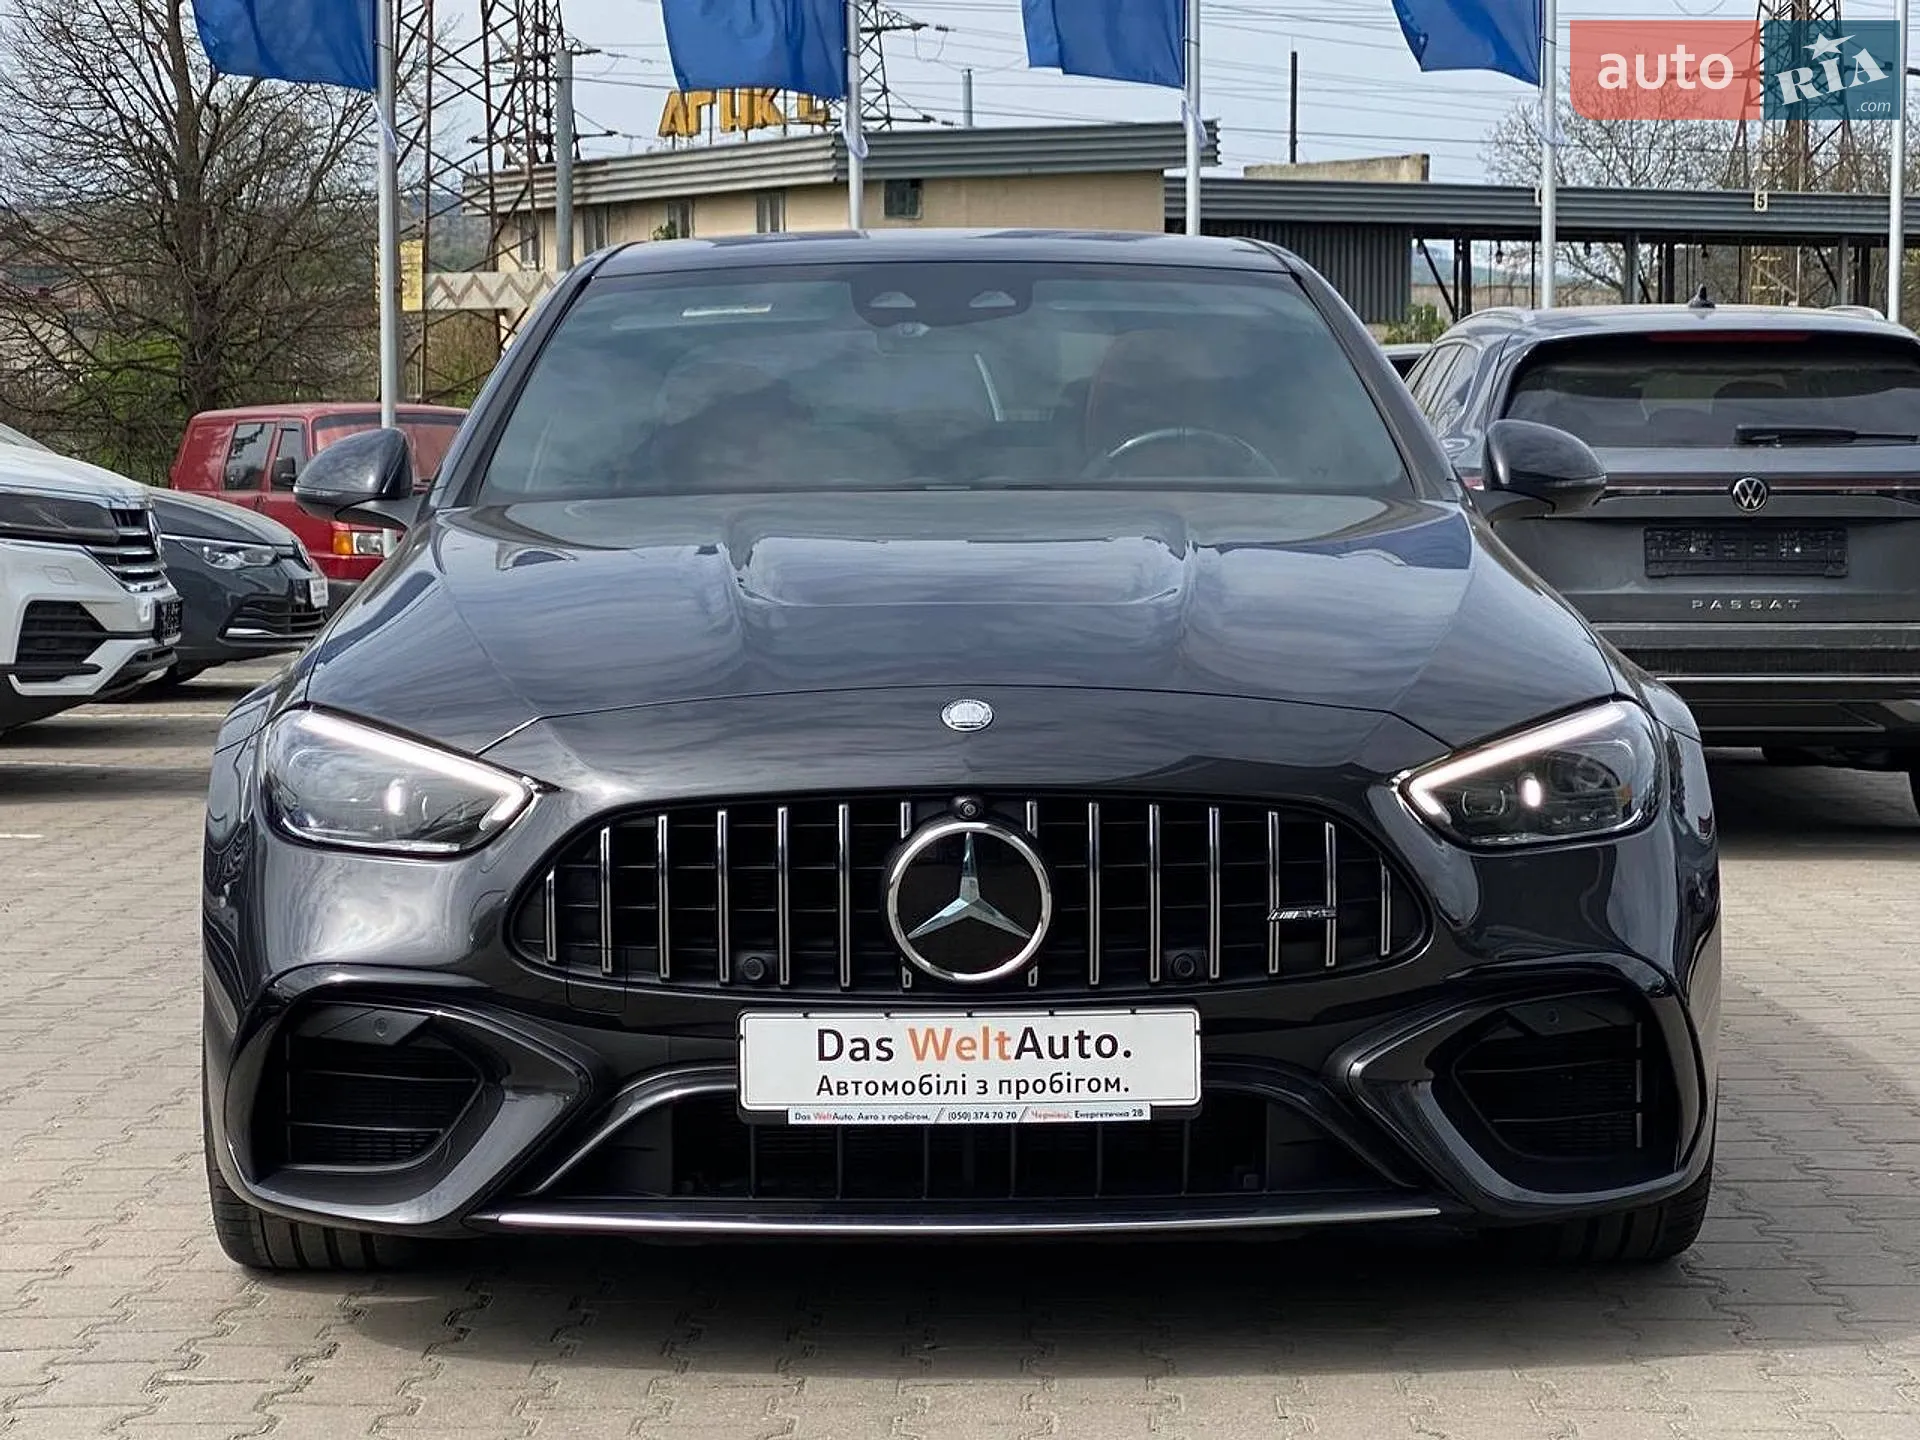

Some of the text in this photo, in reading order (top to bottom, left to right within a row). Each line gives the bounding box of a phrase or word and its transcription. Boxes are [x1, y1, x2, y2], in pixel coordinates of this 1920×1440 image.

[1692, 599, 1801, 610] PASSAT
[817, 1026, 1132, 1062] Das WeltAuto.
[816, 1072, 1129, 1100] Автомобілі з пробігом.
[948, 1111, 971, 1122] (050)
[992, 1111, 1003, 1120] 70
[1006, 1111, 1017, 1120] 70
